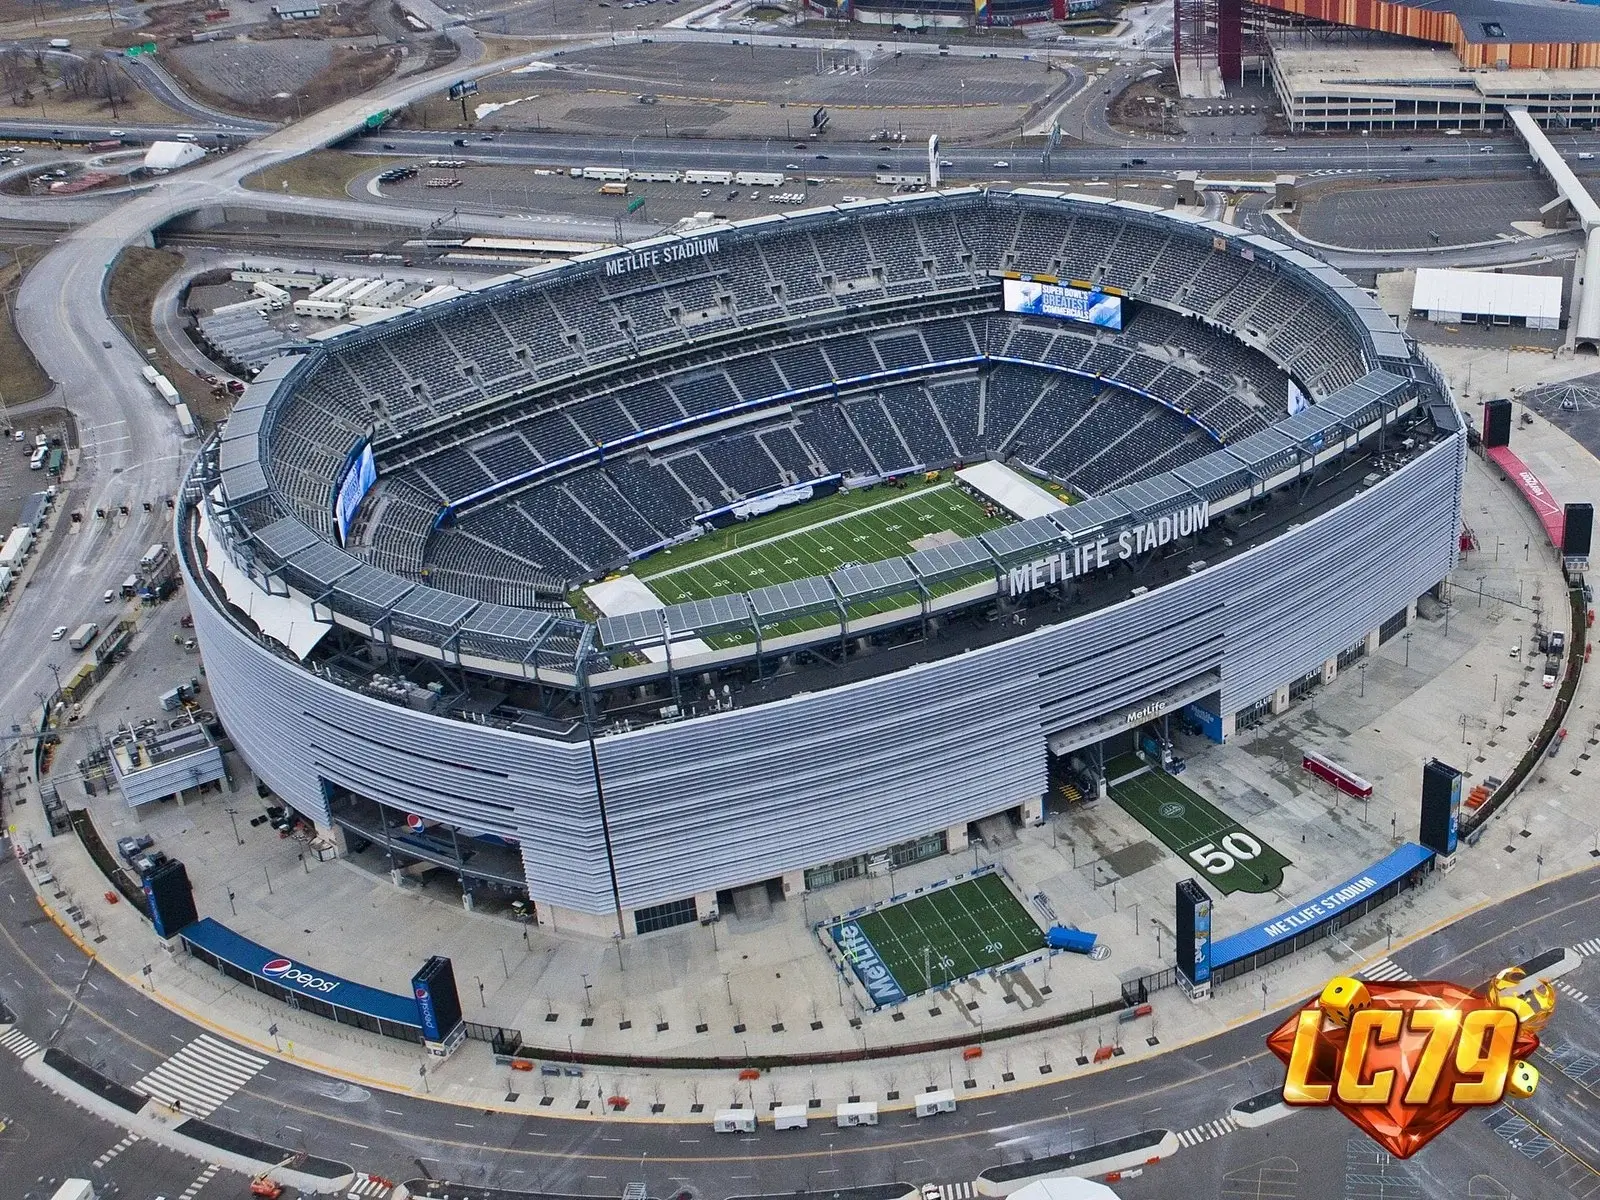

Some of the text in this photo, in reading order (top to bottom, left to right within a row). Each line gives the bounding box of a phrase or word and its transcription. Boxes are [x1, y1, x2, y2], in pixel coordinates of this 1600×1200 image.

[606, 237, 719, 276] METLIFE STADIUM
[1042, 284, 1089, 301] SUPER BOWL'S
[1042, 294, 1089, 311] GREATEST
[1042, 304, 1089, 320] COMMERCIALS
[1009, 500, 1209, 597] METLIFE STADIUM
[1305, 666, 1322, 681] CLUB
[1126, 701, 1166, 724] MetLife
[1255, 694, 1273, 709] CLUB
[1188, 832, 1262, 875] 50
[1263, 876, 1378, 937] METLIFE STADIUM
[984, 941, 1004, 955] 20
[840, 924, 900, 1000] MetLife
[279, 968, 340, 993] pepsi
